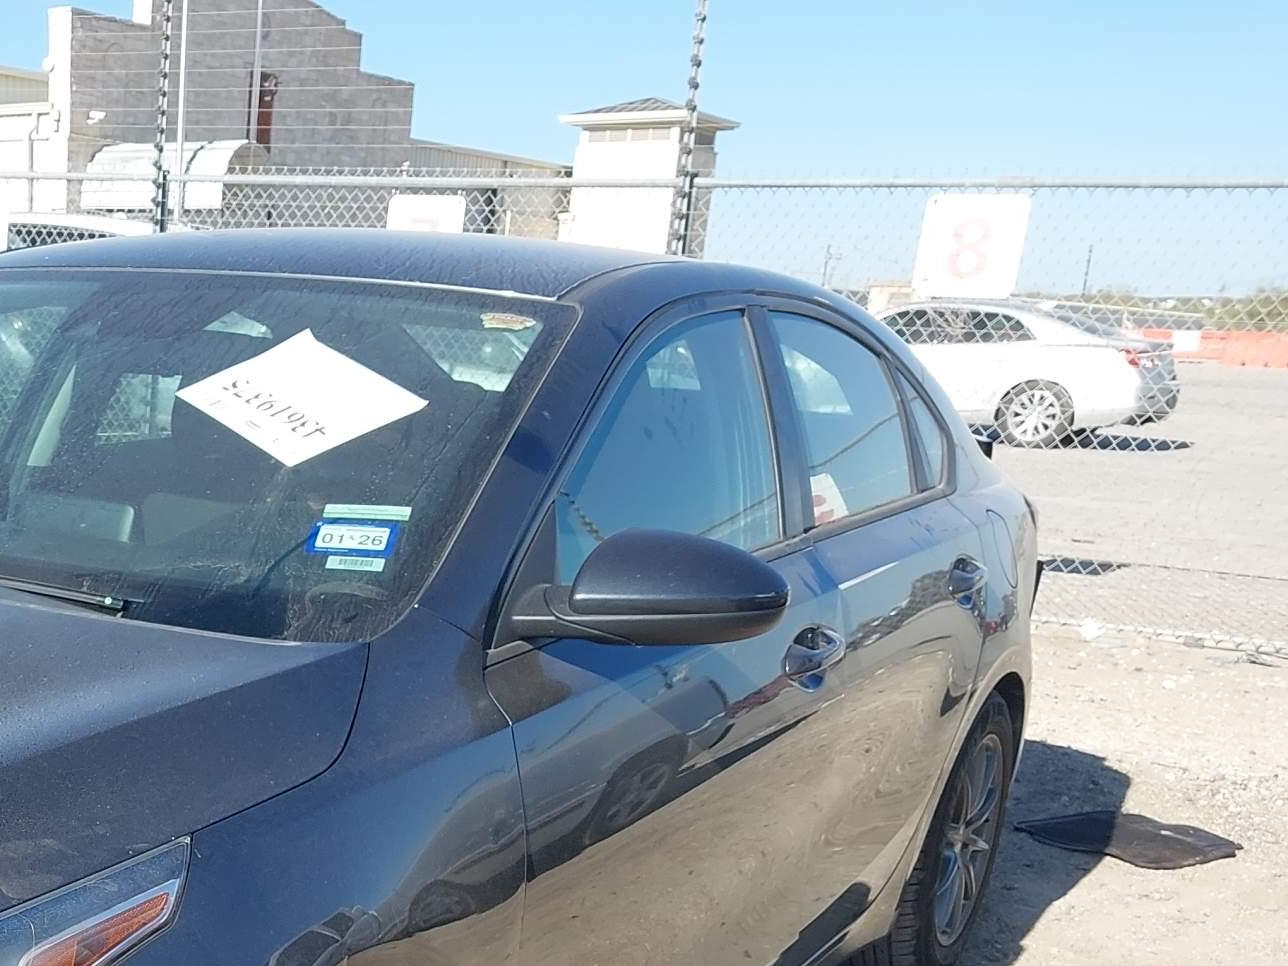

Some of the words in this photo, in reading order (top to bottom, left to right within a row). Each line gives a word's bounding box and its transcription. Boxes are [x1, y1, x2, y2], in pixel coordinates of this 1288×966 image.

[948, 216, 992, 279] 8
[321, 532, 345, 545] 01
[357, 534, 384, 547] 26
